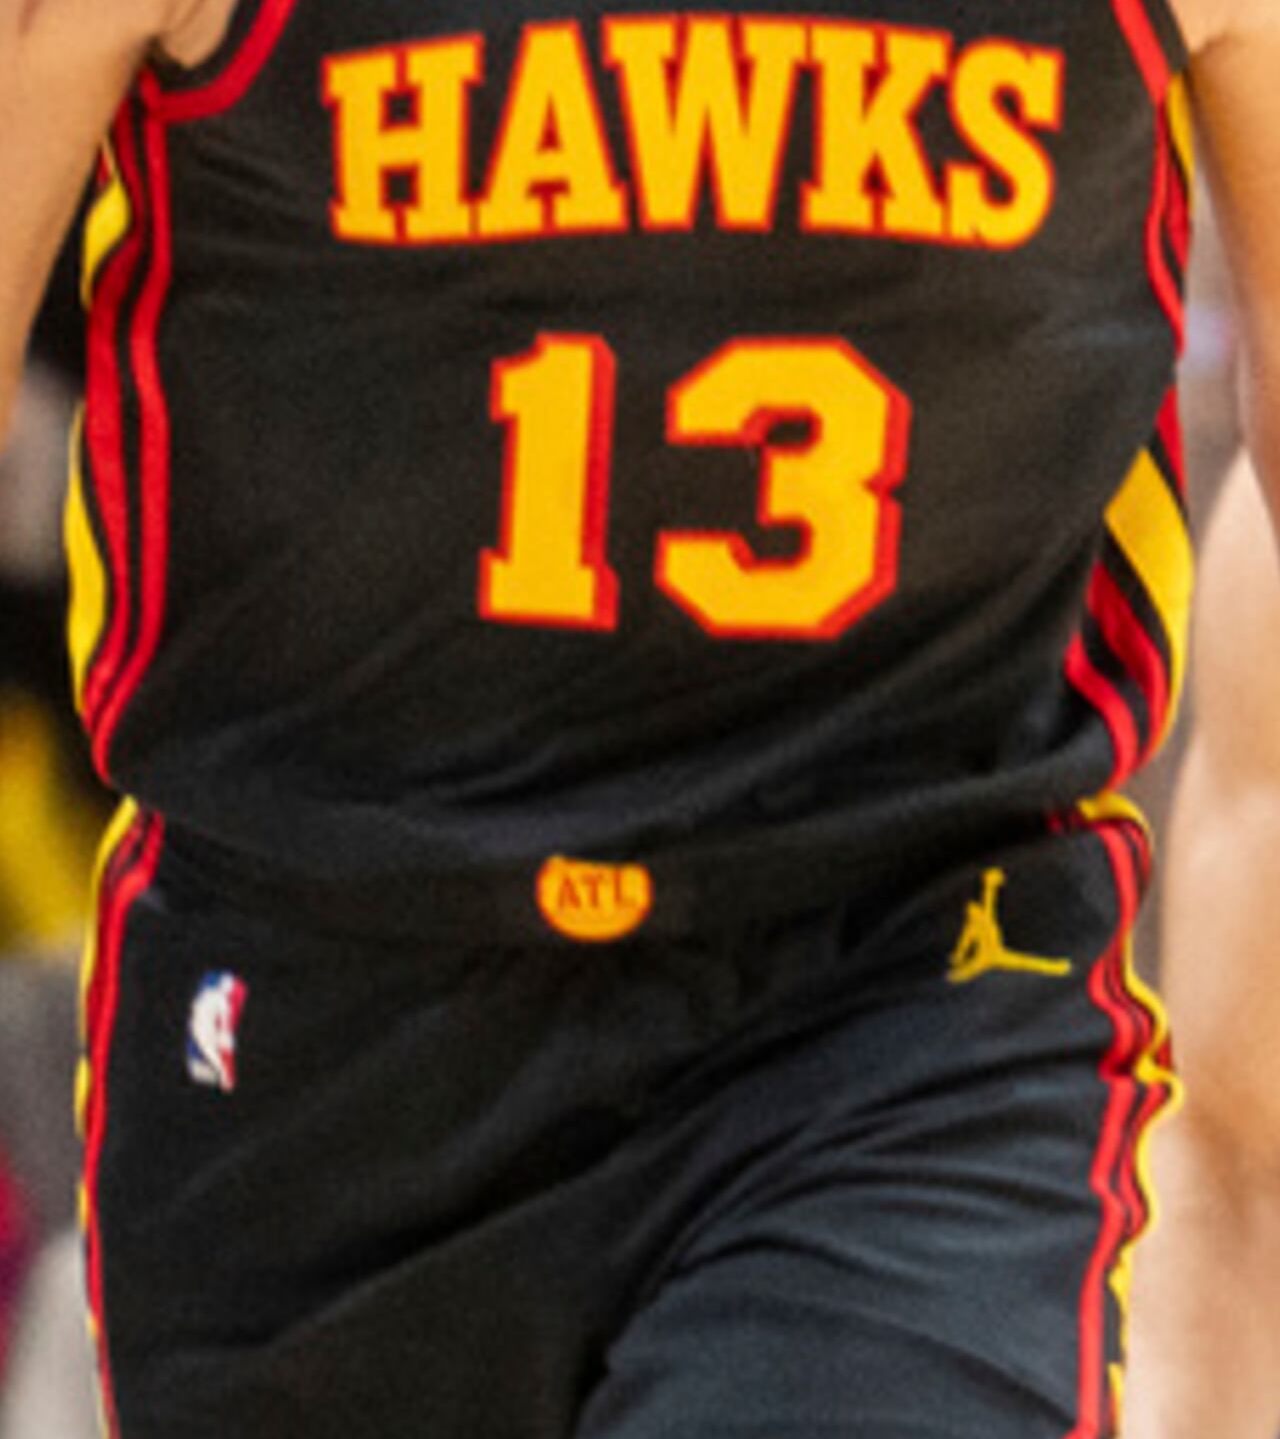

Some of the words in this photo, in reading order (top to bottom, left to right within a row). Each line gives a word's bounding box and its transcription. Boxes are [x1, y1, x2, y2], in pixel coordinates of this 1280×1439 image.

[322, 12, 1065, 251] HAWKS
[477, 330, 912, 641] 13
[556, 871, 639, 911] ATL
